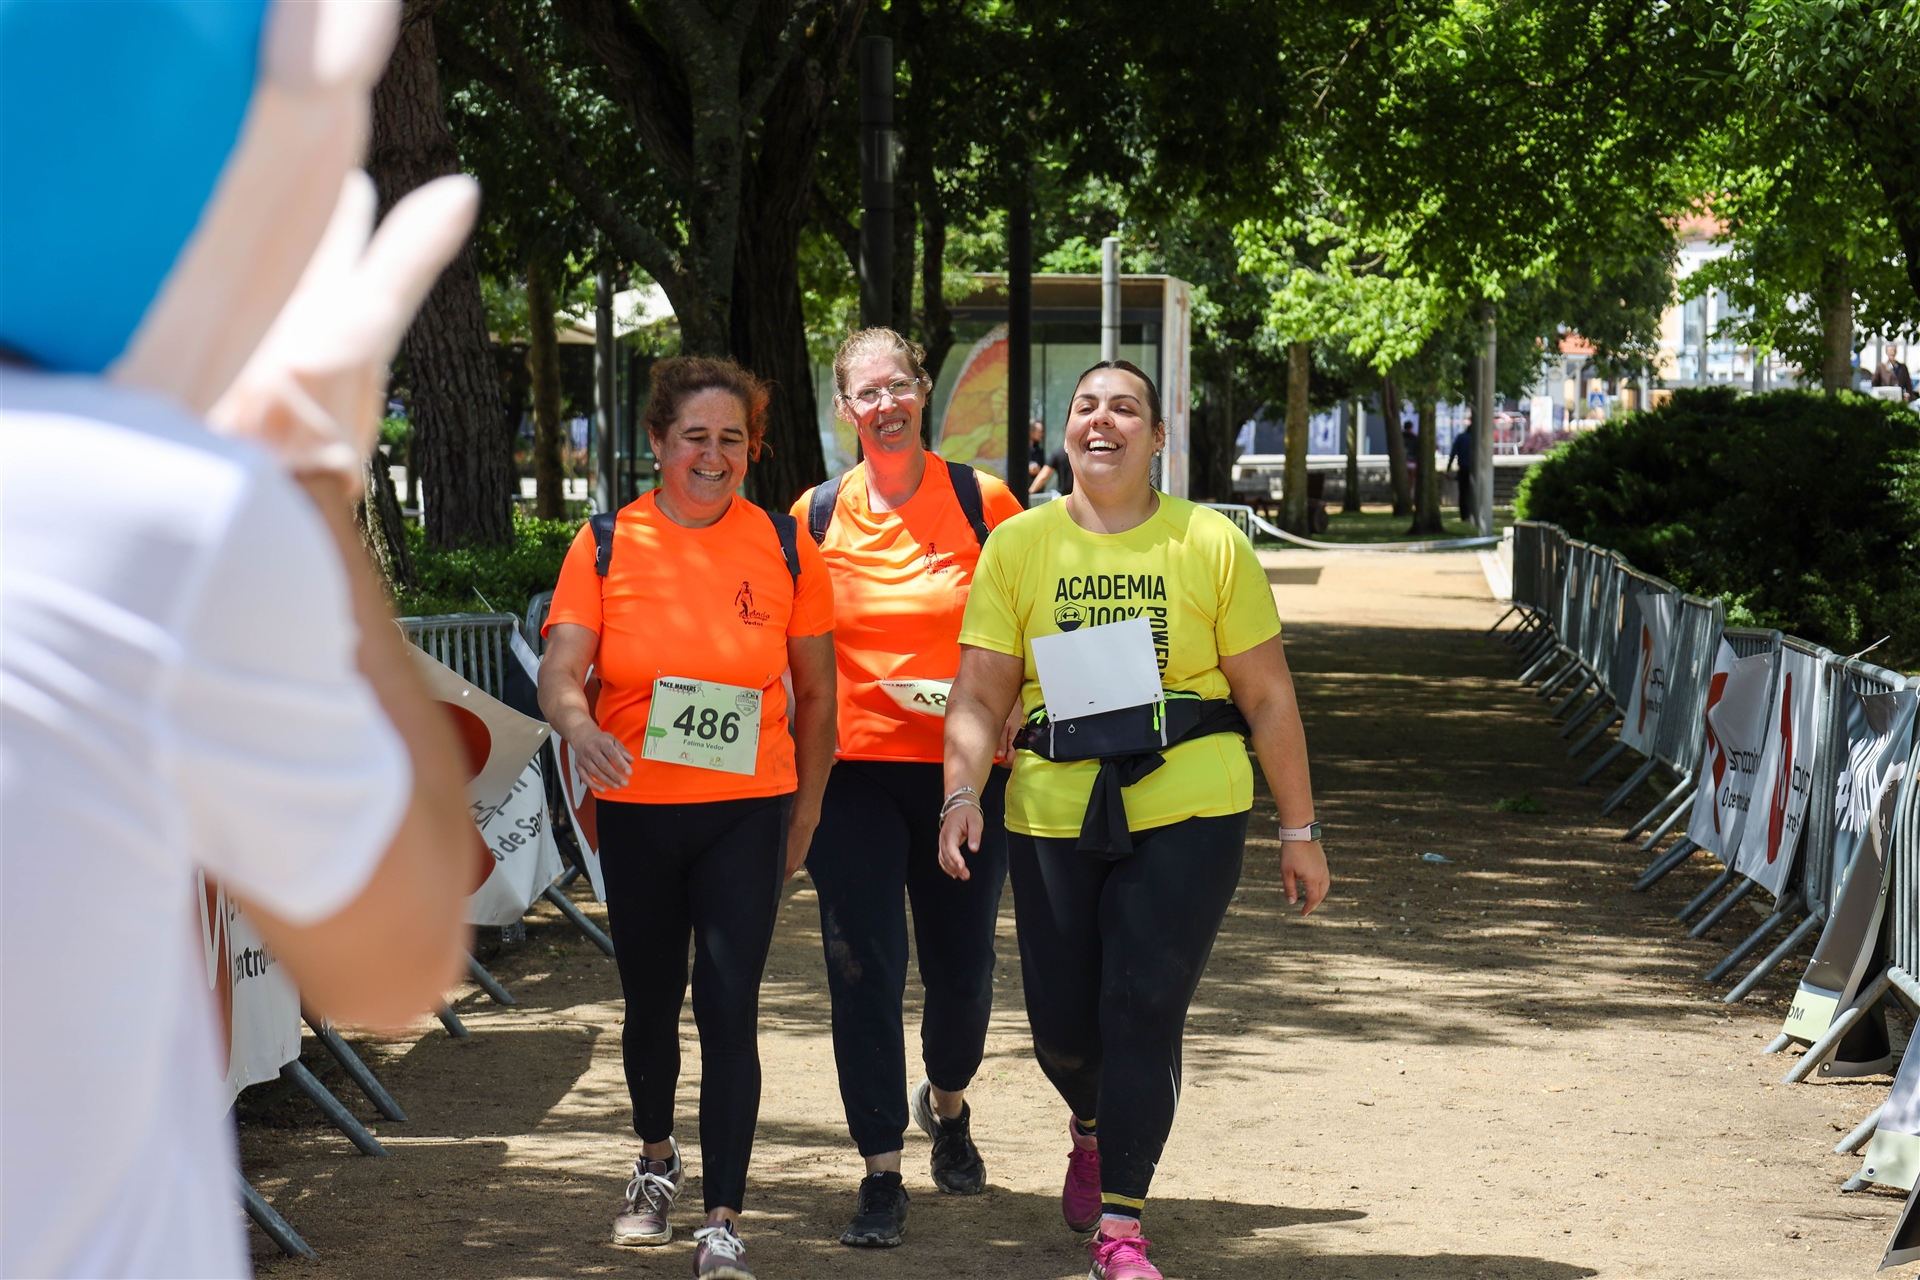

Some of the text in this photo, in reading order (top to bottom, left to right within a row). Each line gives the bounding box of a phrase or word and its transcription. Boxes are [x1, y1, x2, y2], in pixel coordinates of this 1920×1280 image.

[1054, 574, 1167, 602] ACADEMIA
[1088, 606, 1143, 628] 100%
[1146, 606, 1169, 679] POWER
[659, 680, 697, 693] PACE MAKERS
[912, 692, 948, 708] 48
[673, 705, 741, 744] 486
[682, 738, 725, 751] Fatima Vedor
[497, 831, 527, 853] de
[1787, 1005, 1805, 1021] OM
